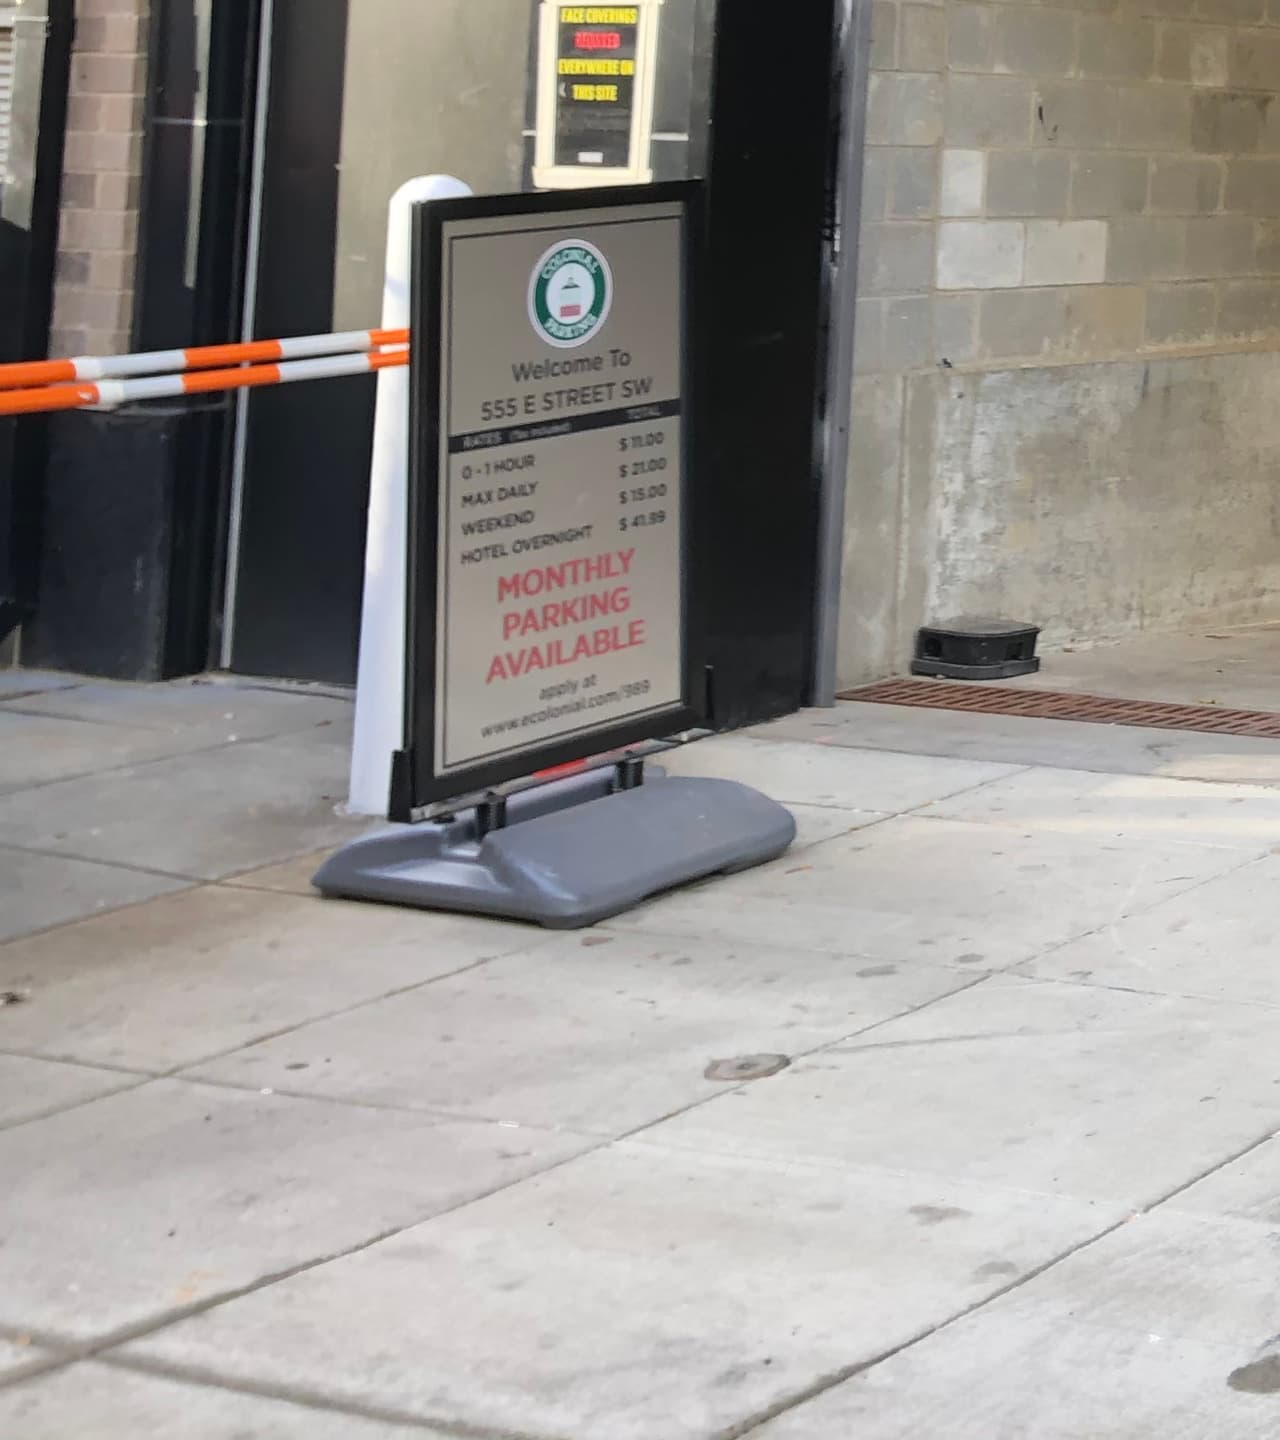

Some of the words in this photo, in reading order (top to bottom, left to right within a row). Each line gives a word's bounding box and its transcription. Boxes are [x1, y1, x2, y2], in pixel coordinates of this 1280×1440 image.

[560, 8, 585, 23] FACE
[586, 8, 637, 24] COVERINGS
[559, 59, 619, 75] EVERYWHERE
[573, 85, 595, 101] THIS
[595, 85, 618, 101] SITE
[512, 355, 603, 382] Welcome
[609, 349, 632, 367] To
[481, 398, 517, 421] 555
[524, 395, 536, 414] E
[542, 382, 616, 411] STREET
[622, 377, 653, 399] SW
[494, 454, 536, 473] HOUR
[461, 489, 494, 508] MAX
[497, 481, 539, 501] DAILY
[461, 510, 536, 536] WEEKEND
[461, 544, 509, 565] HOTEL
[512, 524, 594, 554] OVERNIGHT
[497, 547, 636, 604] MONTHLY
[502, 586, 631, 641] PARKING
[485, 619, 646, 685] AVAILABLE
[539, 679, 579, 701] apply
[582, 674, 598, 689] at
